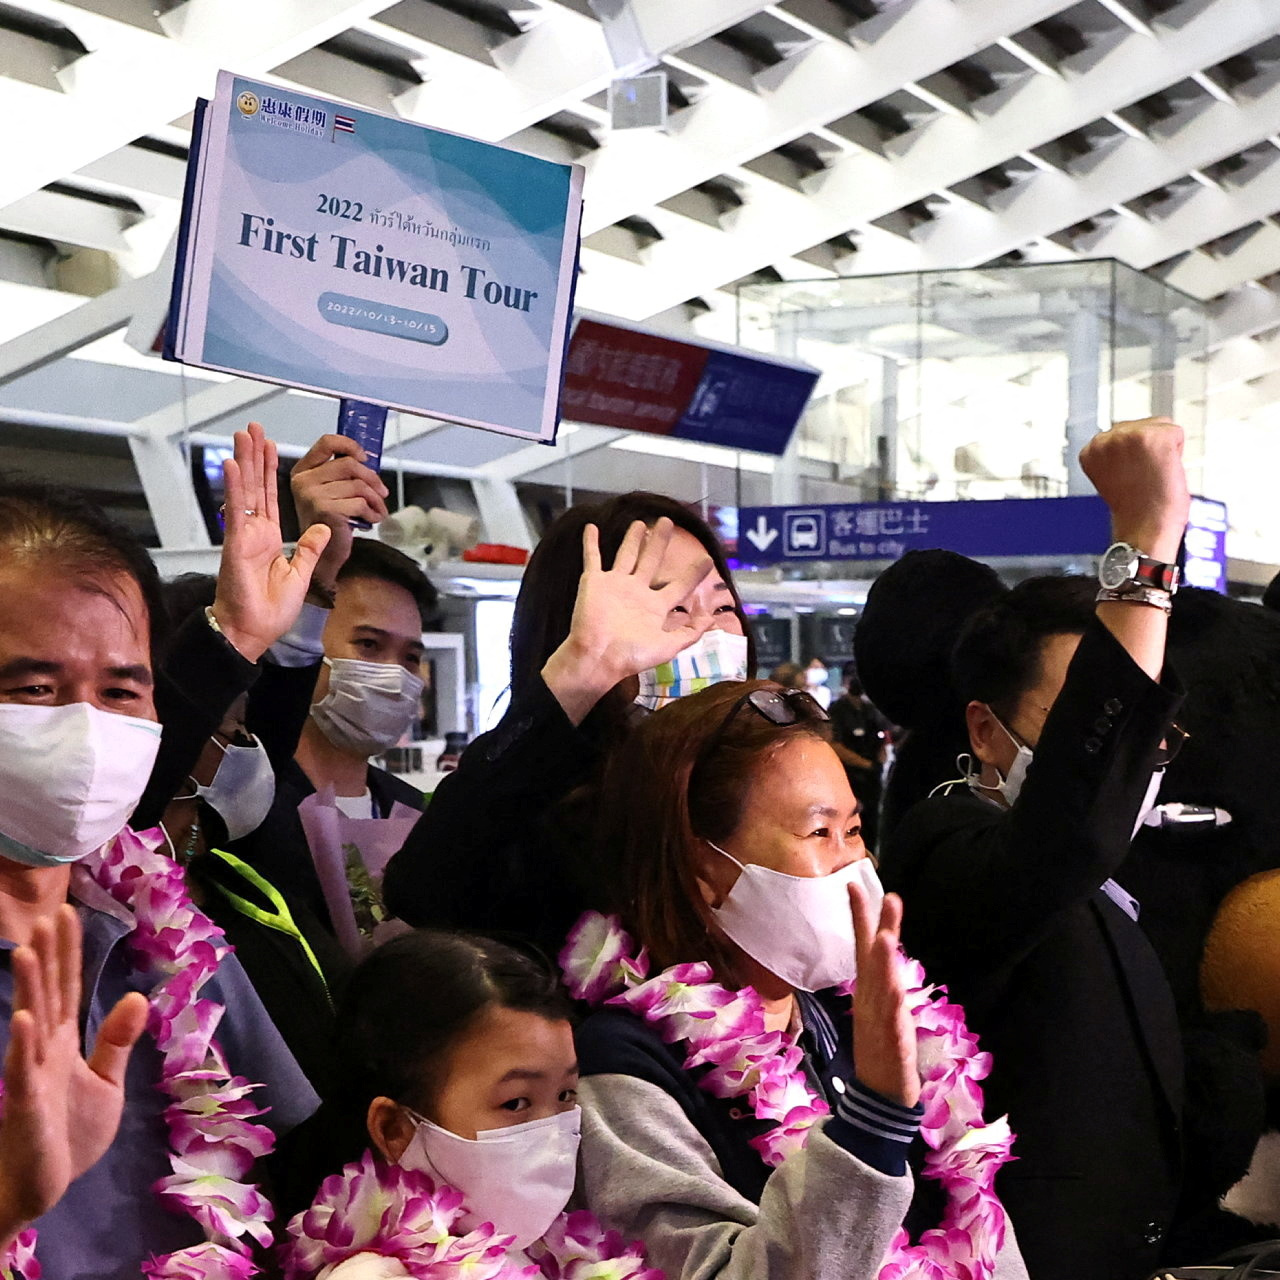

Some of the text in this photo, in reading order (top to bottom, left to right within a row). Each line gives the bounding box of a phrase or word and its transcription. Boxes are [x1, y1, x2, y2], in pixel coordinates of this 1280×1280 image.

[261, 98, 327, 128] 惠康假期
[317, 194, 363, 222] 2022
[237, 212, 538, 312] First Taiwan Tour
